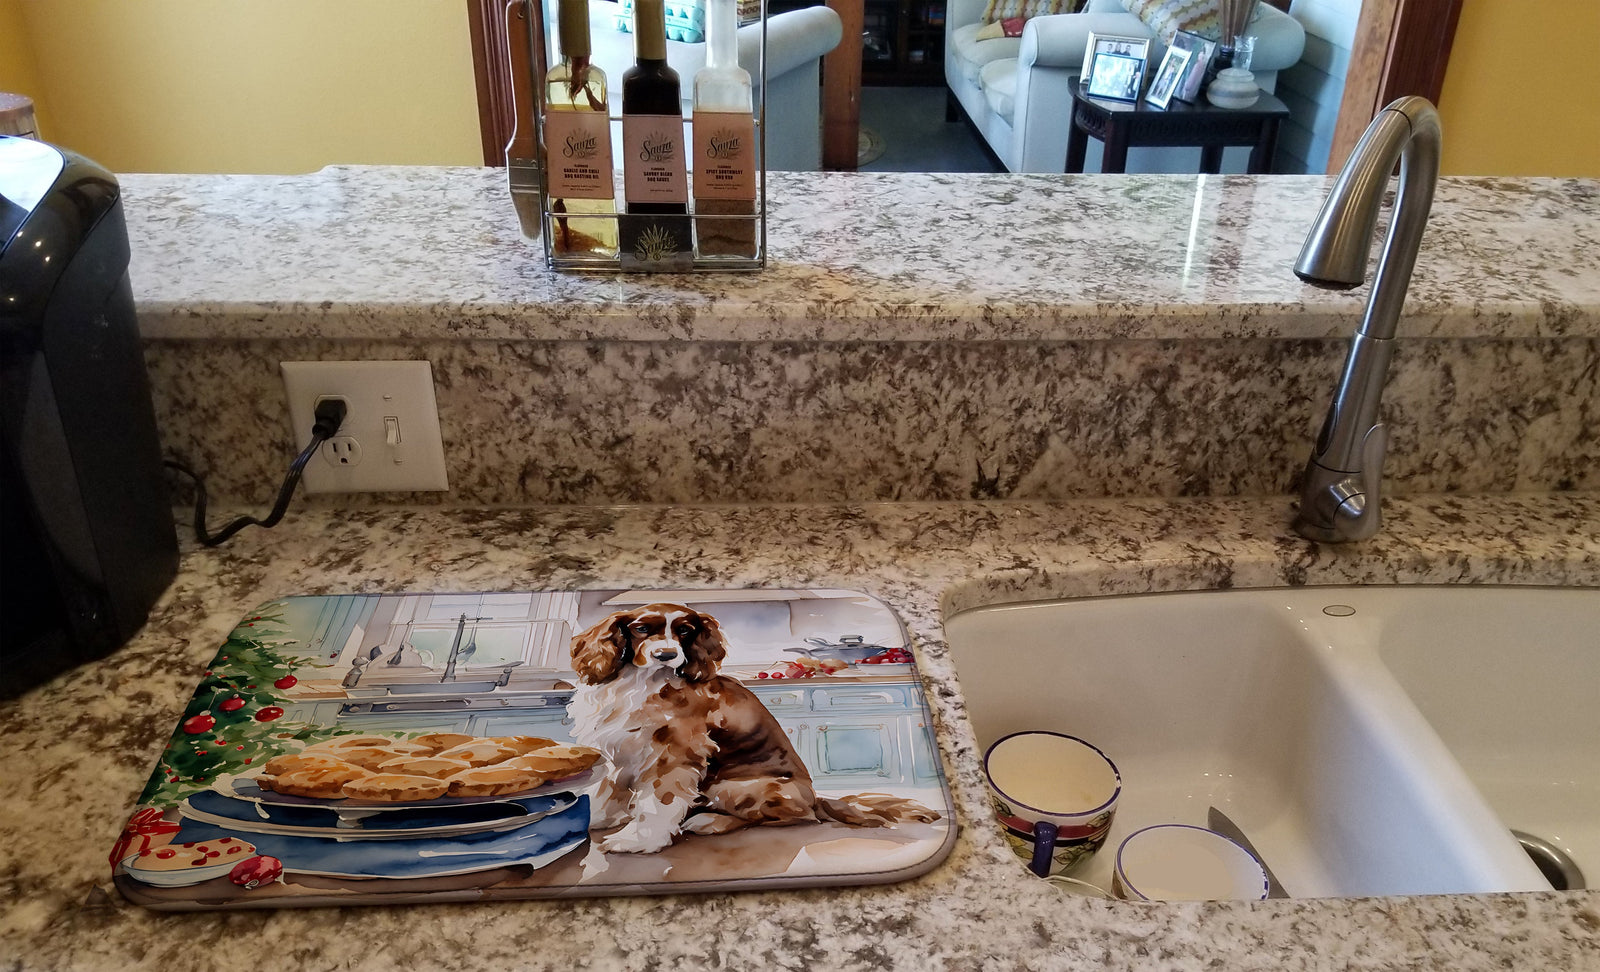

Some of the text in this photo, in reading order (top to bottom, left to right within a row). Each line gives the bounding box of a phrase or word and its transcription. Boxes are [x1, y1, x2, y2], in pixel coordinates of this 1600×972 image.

[562, 136, 597, 158] Sauza
[640, 140, 673, 162] Sauza
[706, 137, 740, 158] Sauza
